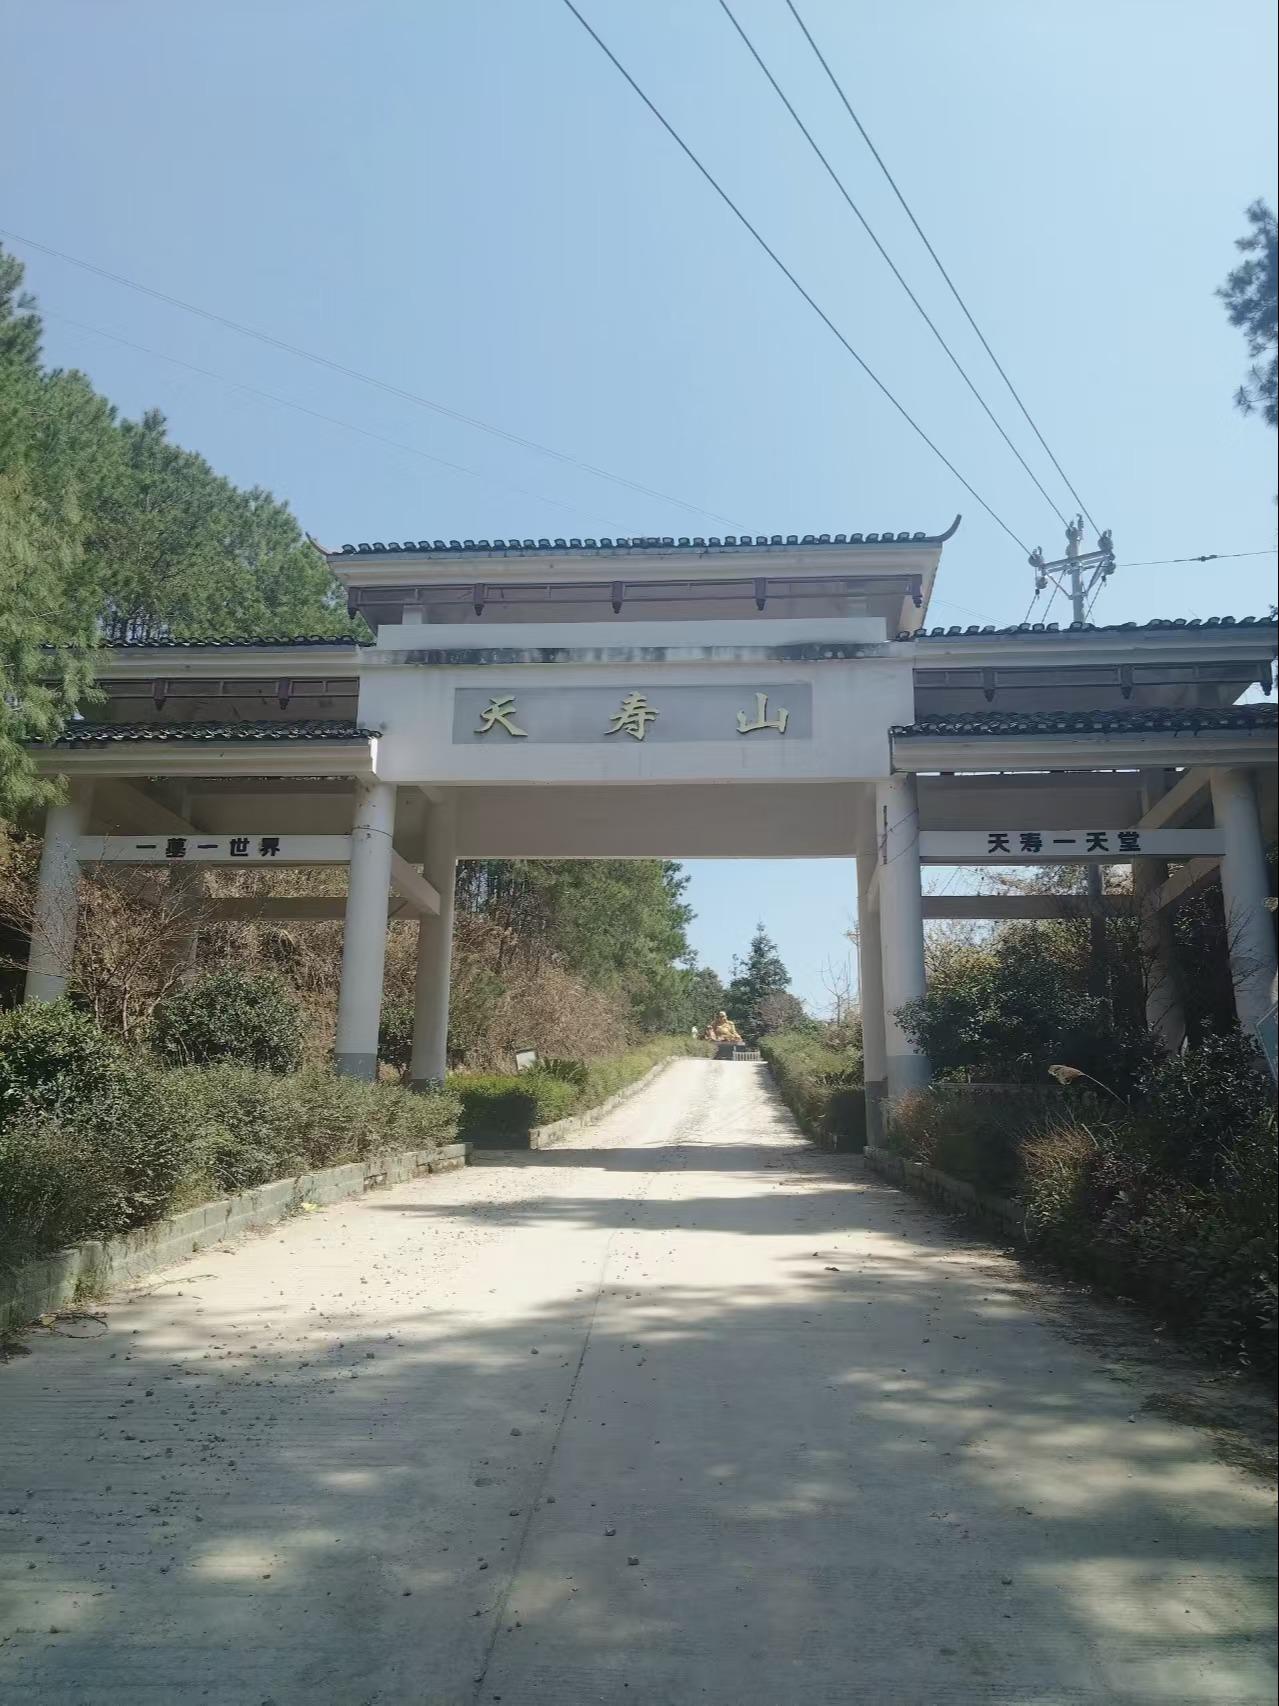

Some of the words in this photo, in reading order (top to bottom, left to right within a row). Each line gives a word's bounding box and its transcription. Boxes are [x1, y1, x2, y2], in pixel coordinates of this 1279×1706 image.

[473, 691, 789, 741] 天寿山
[135, 837, 281, 858] 一墓一世界
[987, 831, 1141, 854] 天寿一天堂
